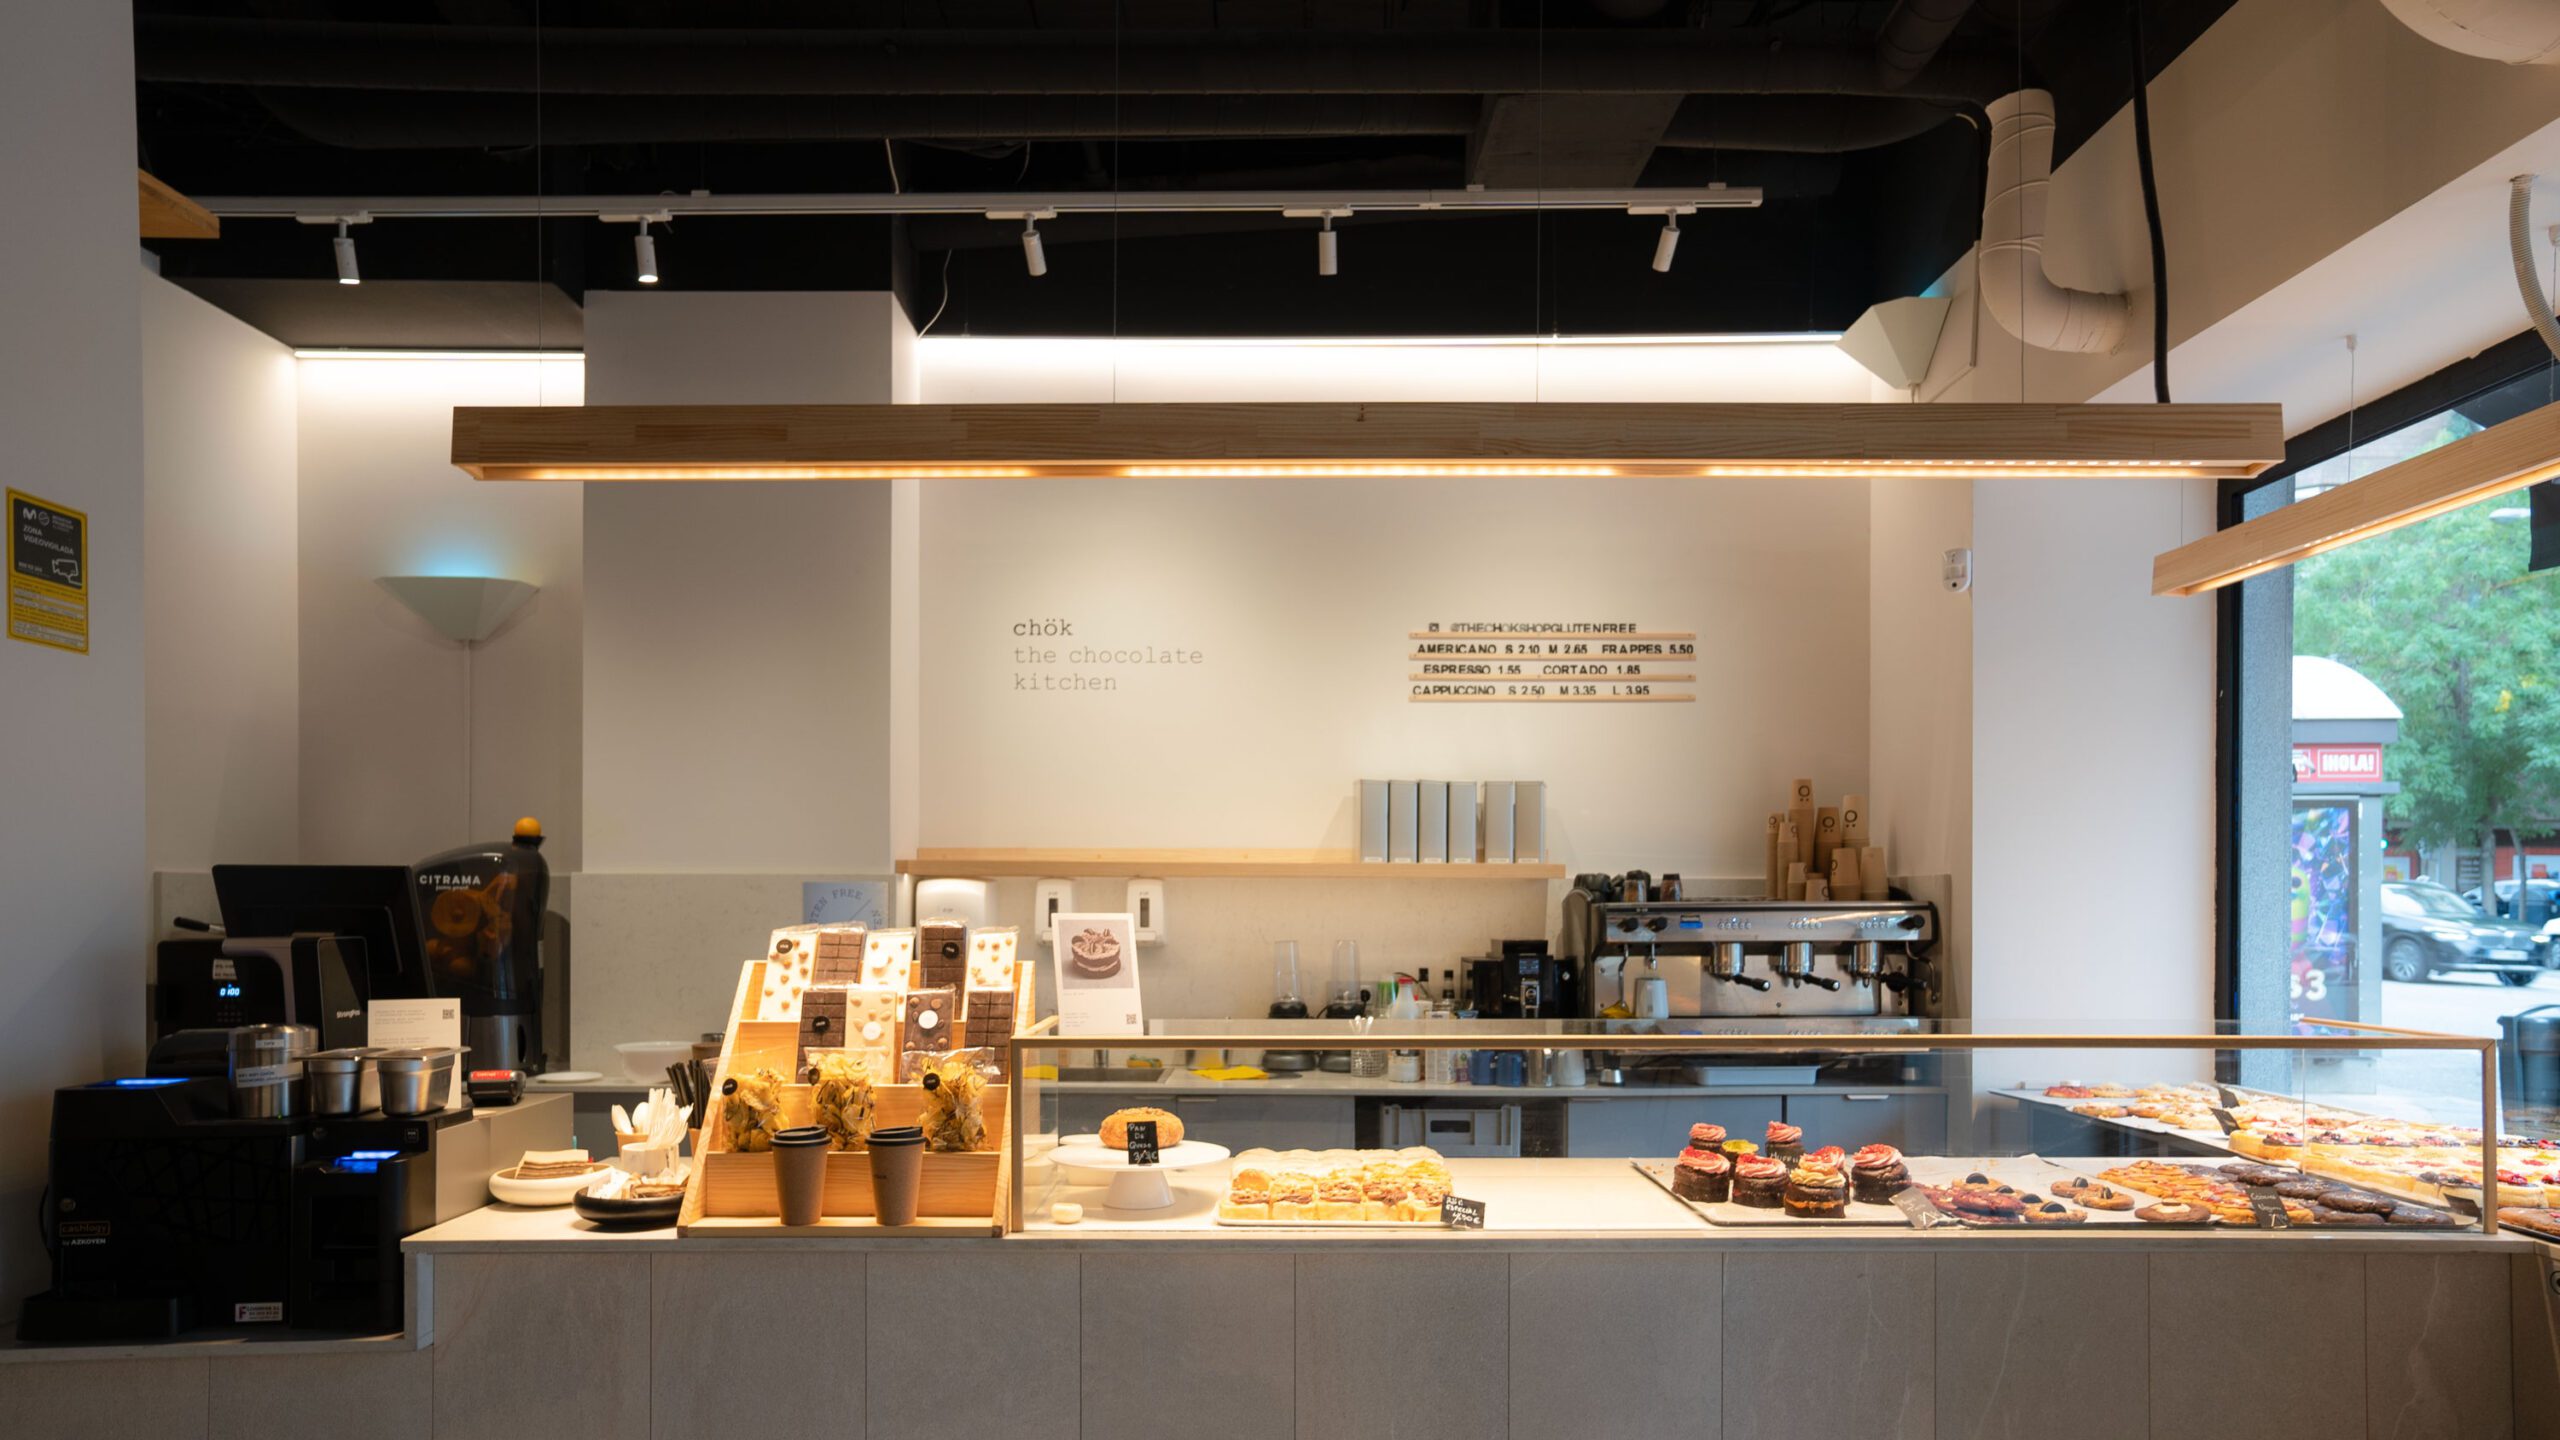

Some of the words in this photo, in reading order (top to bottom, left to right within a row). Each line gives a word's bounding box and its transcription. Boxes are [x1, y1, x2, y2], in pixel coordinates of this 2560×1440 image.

[23, 533, 74, 556] VIDEOVIGILADA
[1012, 618, 1074, 637] chök
[1014, 646, 1057, 664] the
[1068, 645, 1204, 664] chocolate
[1417, 643, 1497, 655] AMERICANO
[1504, 644, 1514, 655] S
[1548, 644, 1558, 655] M
[1601, 643, 1662, 655] FRAPPES
[1423, 664, 1492, 675] ESPRESSO
[1542, 664, 1608, 675] CORTADO
[1013, 672, 1118, 691] kitchen
[1412, 685, 1496, 696] CAPPUCCINO
[1508, 685, 1517, 696] S
[1559, 685, 1569, 696] M
[419, 874, 481, 886] CITRAMA
